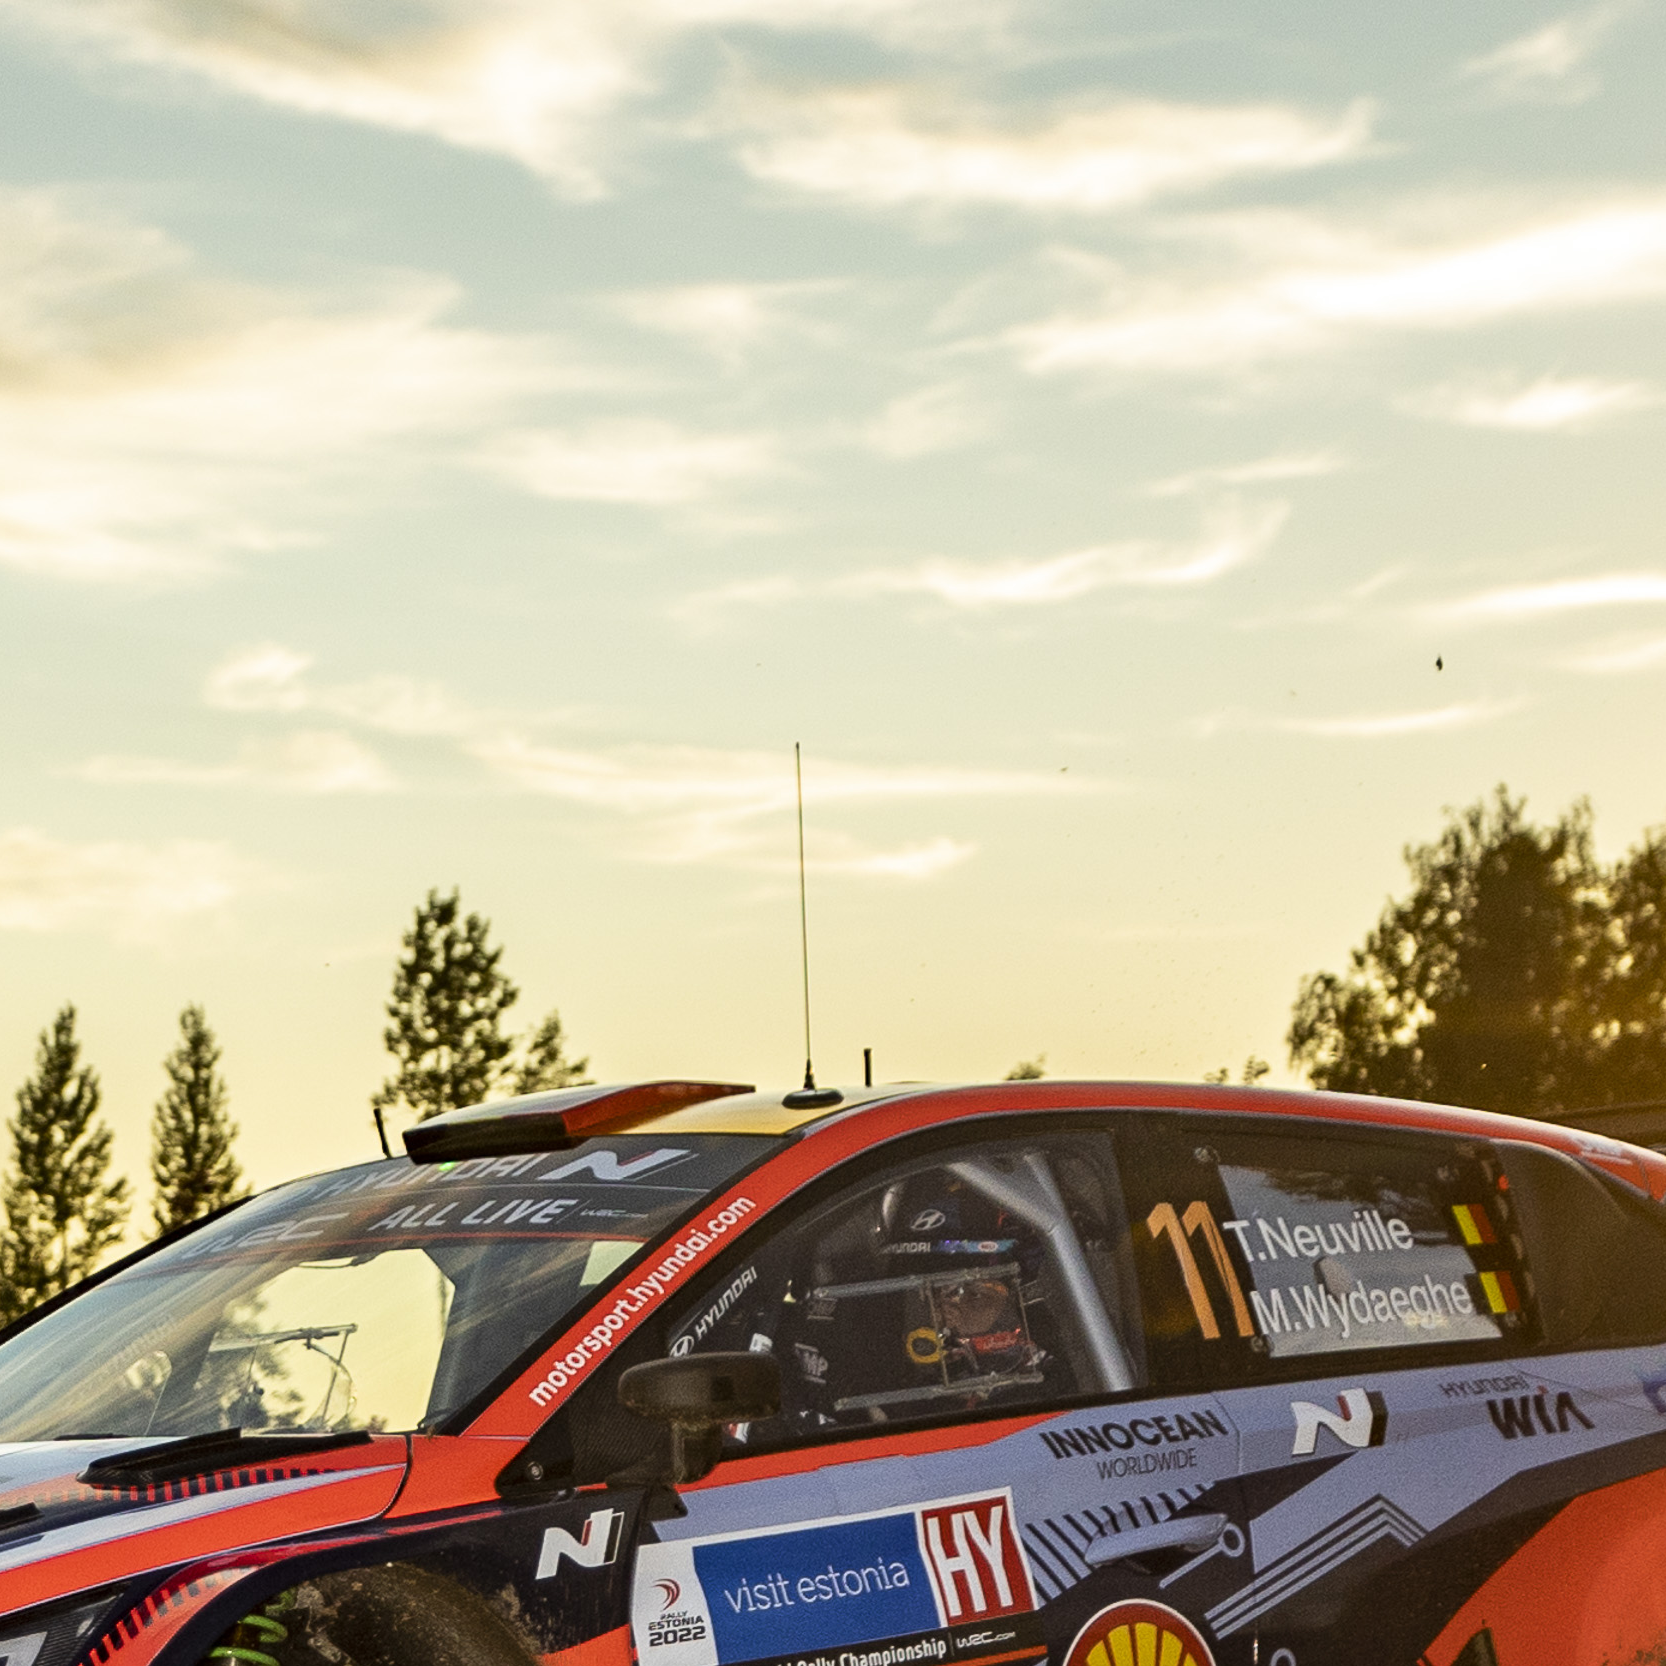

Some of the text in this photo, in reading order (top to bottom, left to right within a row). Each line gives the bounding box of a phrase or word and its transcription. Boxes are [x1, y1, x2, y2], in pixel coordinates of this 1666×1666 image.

[367, 1202, 459, 1231] ALL
[461, 1199, 579, 1226] LIVE
[1223, 1209, 1414, 1264] T.Neuville
[1146, 1201, 1254, 1339] 11
[528, 1196, 756, 1407] motorsport.hyundai.com
[695, 1266, 757, 1340] HYUNDAI
[1250, 1272, 1473, 1339] M.Wydaeghe
[1438, 1373, 1530, 1398] HYUNDAI
[1040, 1408, 1229, 1460] INNOCEAN
[1290, 1387, 1387, 1457] N
[1096, 1447, 1198, 1480] WORLDWIDE
[535, 1508, 624, 1580] N
[926, 1504, 1014, 1618] HY
[724, 1556, 911, 1614] visit estonia
[648, 1614, 704, 1632] ESTONIA
[649, 1626, 706, 1647] 2022
[660, 1610, 688, 1621] RALLY
